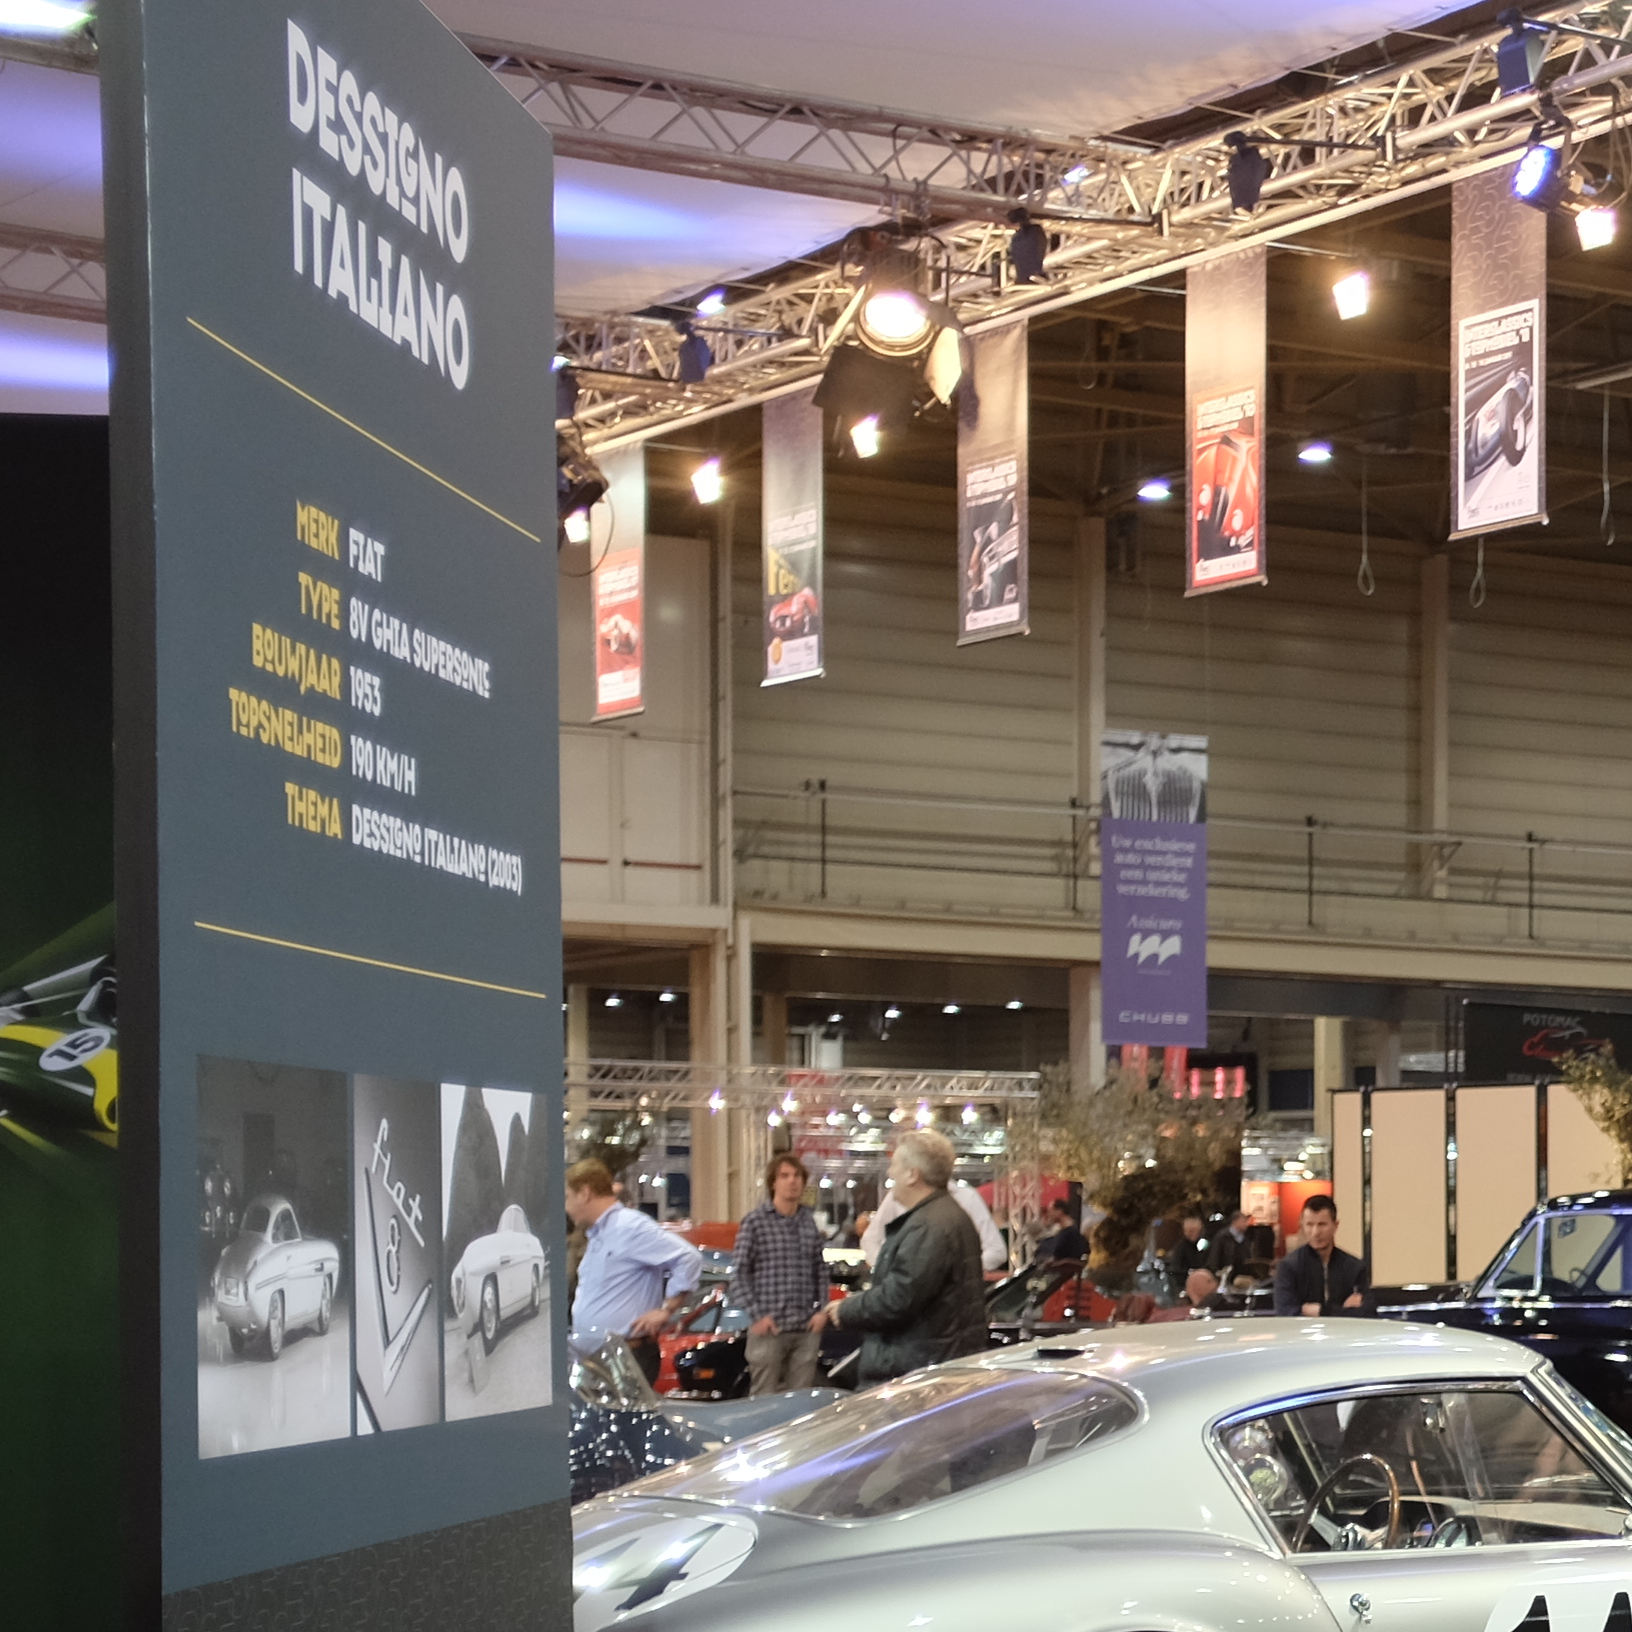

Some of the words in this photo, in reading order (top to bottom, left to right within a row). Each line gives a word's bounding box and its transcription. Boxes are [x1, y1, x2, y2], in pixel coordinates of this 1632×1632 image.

[287, 18, 469, 264] DESSIGNO
[292, 167, 470, 390] ITALIANO
[297, 500, 339, 560] MERK
[349, 528, 385, 583] FIAT
[252, 622, 341, 700] BOUWJAAR
[350, 666, 381, 717] 1953
[299, 572, 340, 631] TYPE
[349, 597, 369, 643] 8V
[371, 608, 410, 664] GHIA
[413, 628, 491, 699] SUPERSONIC
[229, 687, 342, 769] TOPSNELHEID
[350, 735, 373, 782] 190
[376, 745, 416, 797] KM/H
[285, 782, 342, 839] THEMA
[352, 804, 421, 864] DESSIGNO
[424, 827, 486, 883] ITALIANO
[488, 848, 522, 897] (2003)
[46, 1033, 105, 1063] 15
[1118, 1010, 1189, 1025] CHUBB
